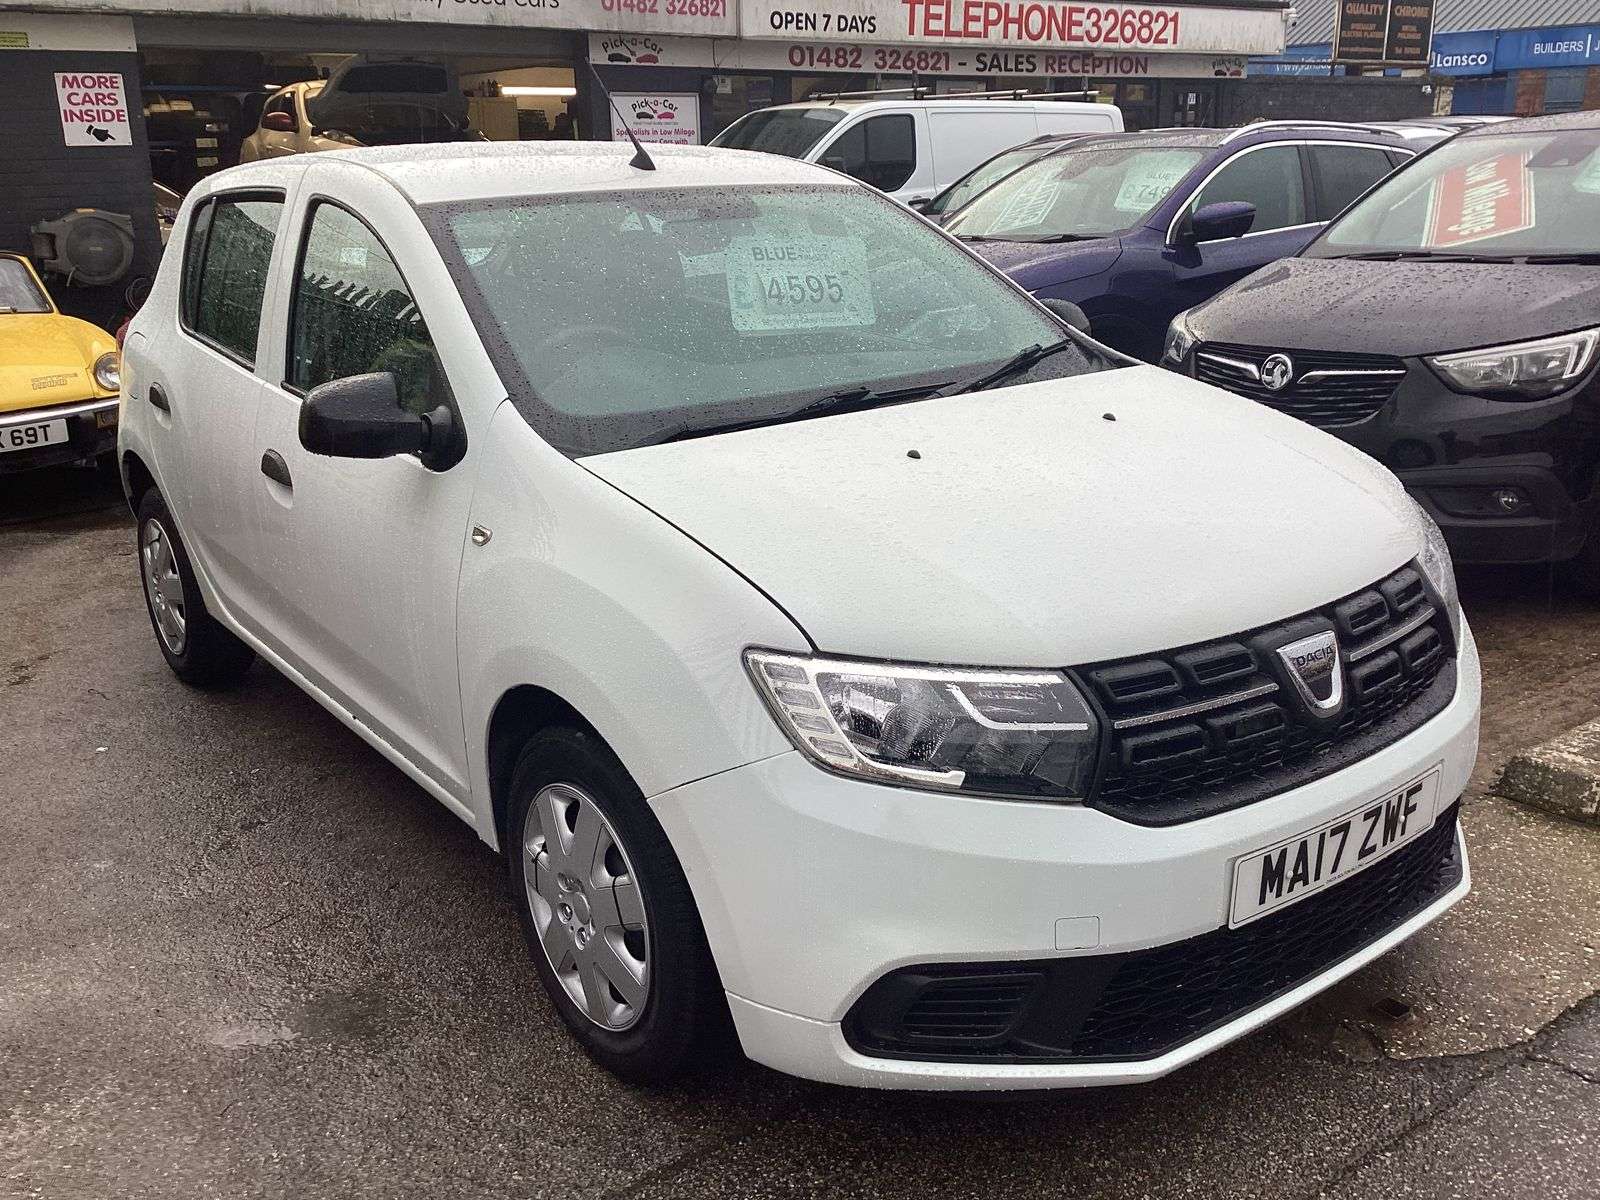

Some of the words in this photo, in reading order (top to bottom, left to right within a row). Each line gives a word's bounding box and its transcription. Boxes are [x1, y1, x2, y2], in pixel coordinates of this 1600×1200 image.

[1346, 3, 1384, 15] QUALITY
[770, 11, 817, 31] OPEN
[823, 13, 831, 32] 7
[838, 15, 877, 33] DAYS
[601, 33, 664, 54] Pick-a-Car
[1533, 40, 1584, 55] BUILDERS
[788, 44, 862, 69] 01482
[874, 48, 950, 72] 326821
[975, 52, 1037, 74] SALES
[1044, 53, 1149, 75] RECEPTION
[1436, 53, 1488, 67] Lansco
[61, 75, 119, 89] MORE
[66, 92, 119, 106] CARS
[631, 98, 678, 112] Pick-a-Car
[62, 109, 126, 123] INSIDE
[616, 128, 650, 136] Spialists
[752, 246, 799, 262] BLUE
[10, 424, 51, 447] 69T
[1296, 644, 1334, 667] DACIA
[1258, 820, 1352, 907] MA17
[1356, 782, 1423, 862] ZWF
